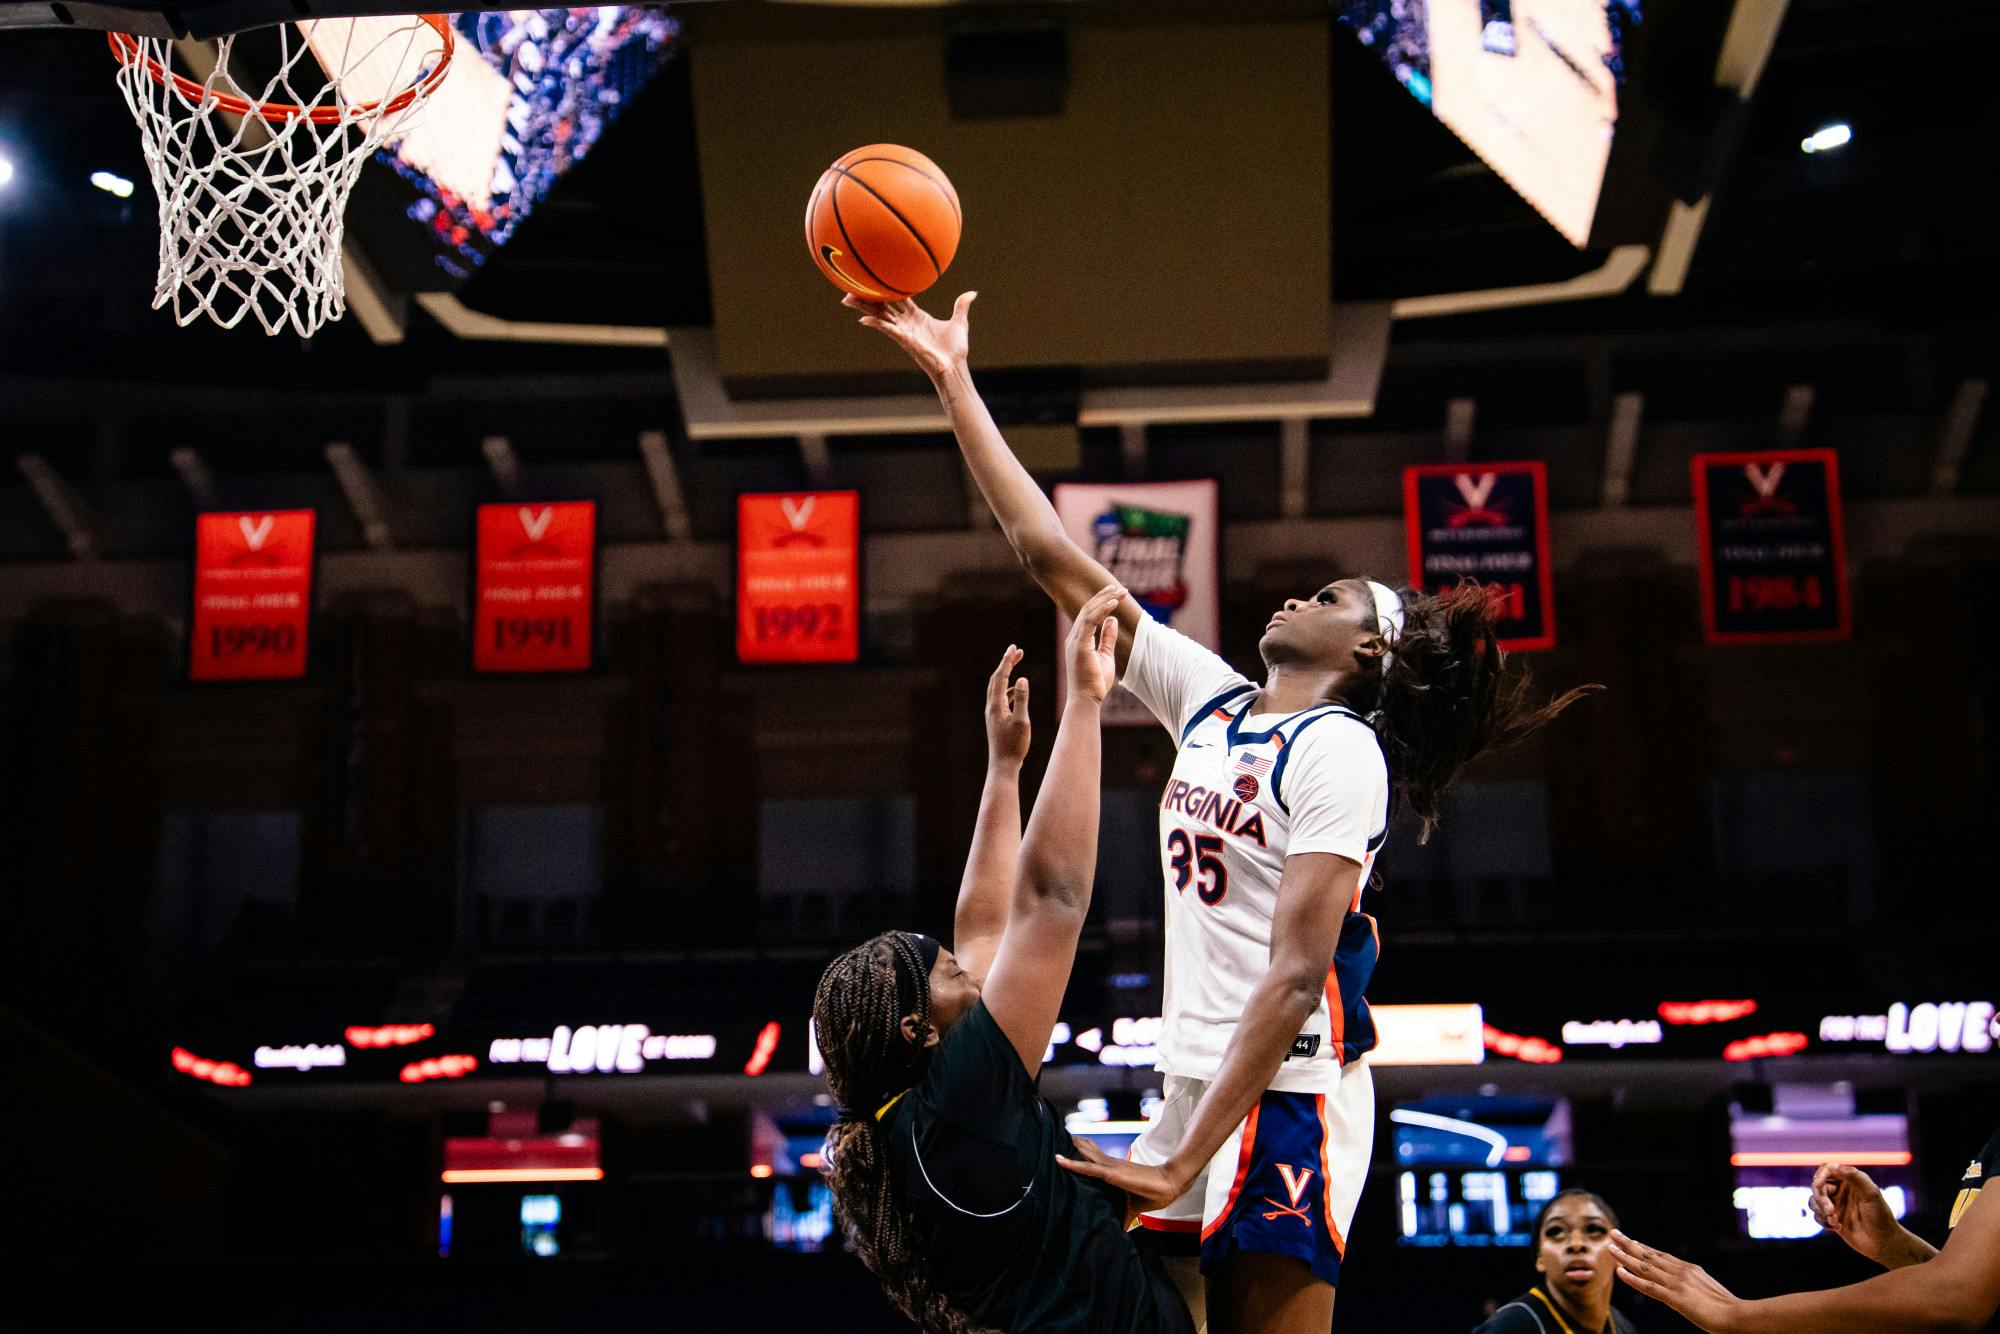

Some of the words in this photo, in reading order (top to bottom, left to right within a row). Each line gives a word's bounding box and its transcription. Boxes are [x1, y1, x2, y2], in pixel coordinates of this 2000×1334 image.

[495, 616, 572, 649] 1991
[756, 603, 843, 641] 1992
[1167, 827, 1228, 907] 35
[547, 1024, 650, 1073] LOVE
[1295, 1039, 1309, 1050] 44
[1885, 1001, 1995, 1054] LOVE
